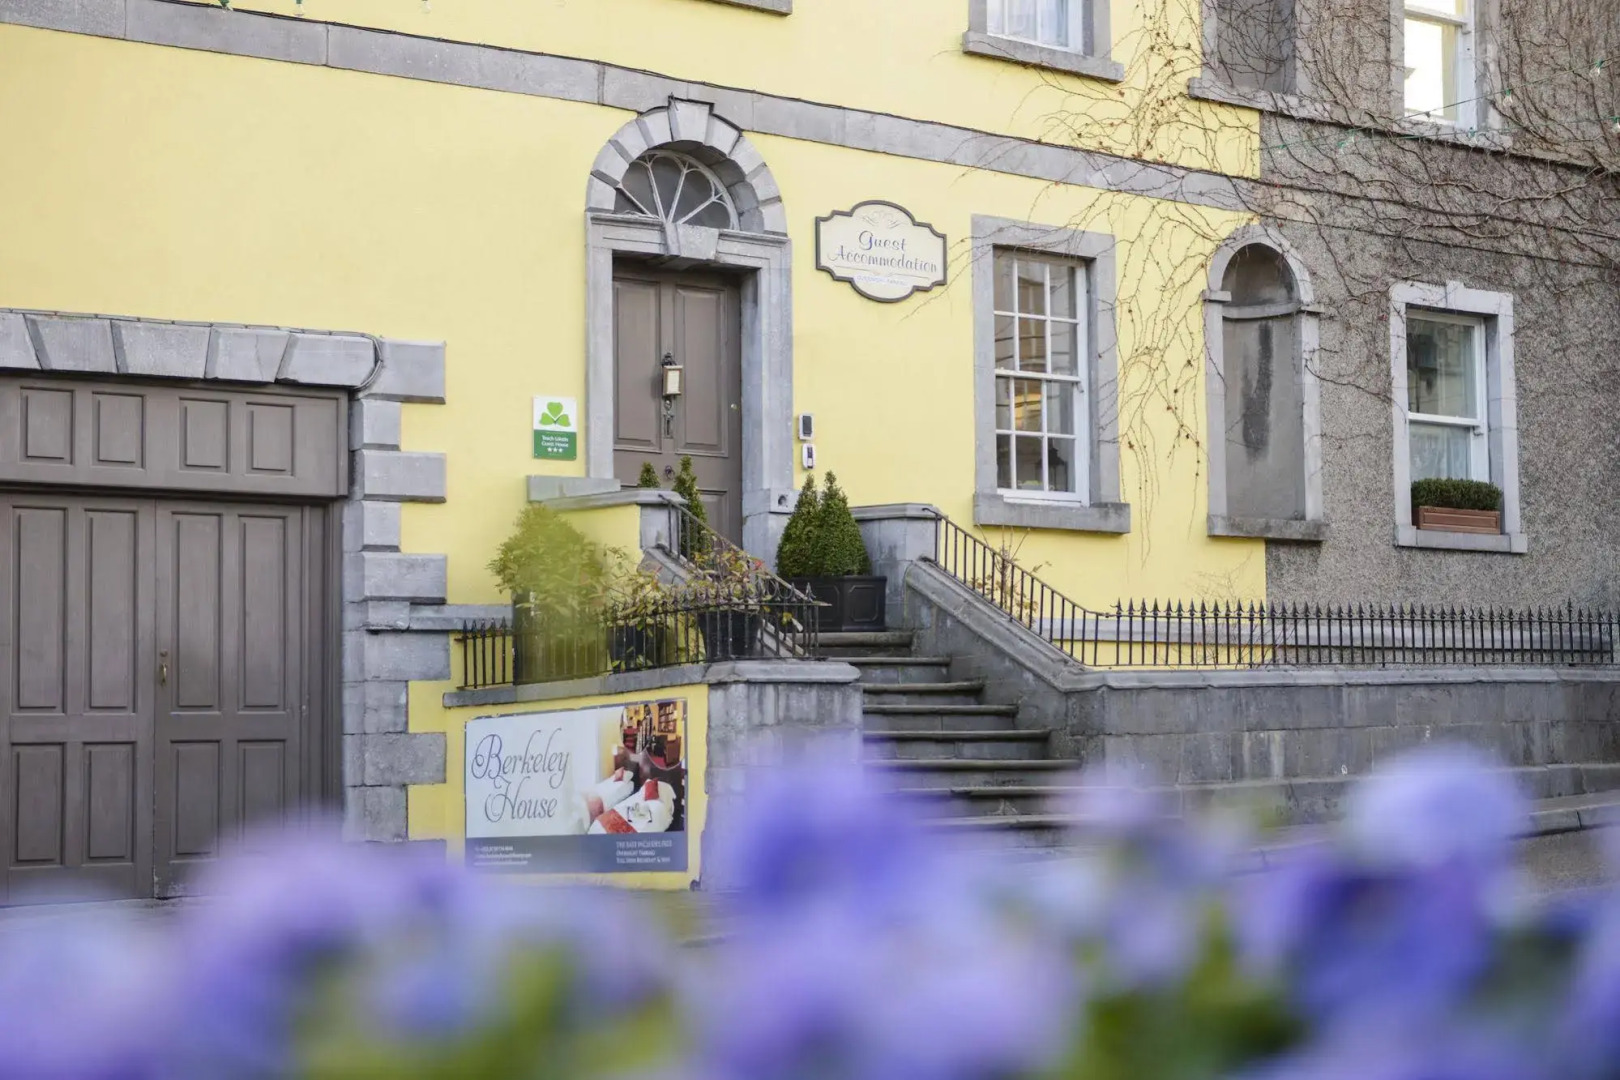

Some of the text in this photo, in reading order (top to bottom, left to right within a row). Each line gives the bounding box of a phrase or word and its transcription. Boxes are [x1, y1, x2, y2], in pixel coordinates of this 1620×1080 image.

[827, 245, 937, 273] Accommodation
[858, 230, 906, 252] Guest
[471, 728, 570, 789] Berkeley
[484, 776, 558, 823] House
